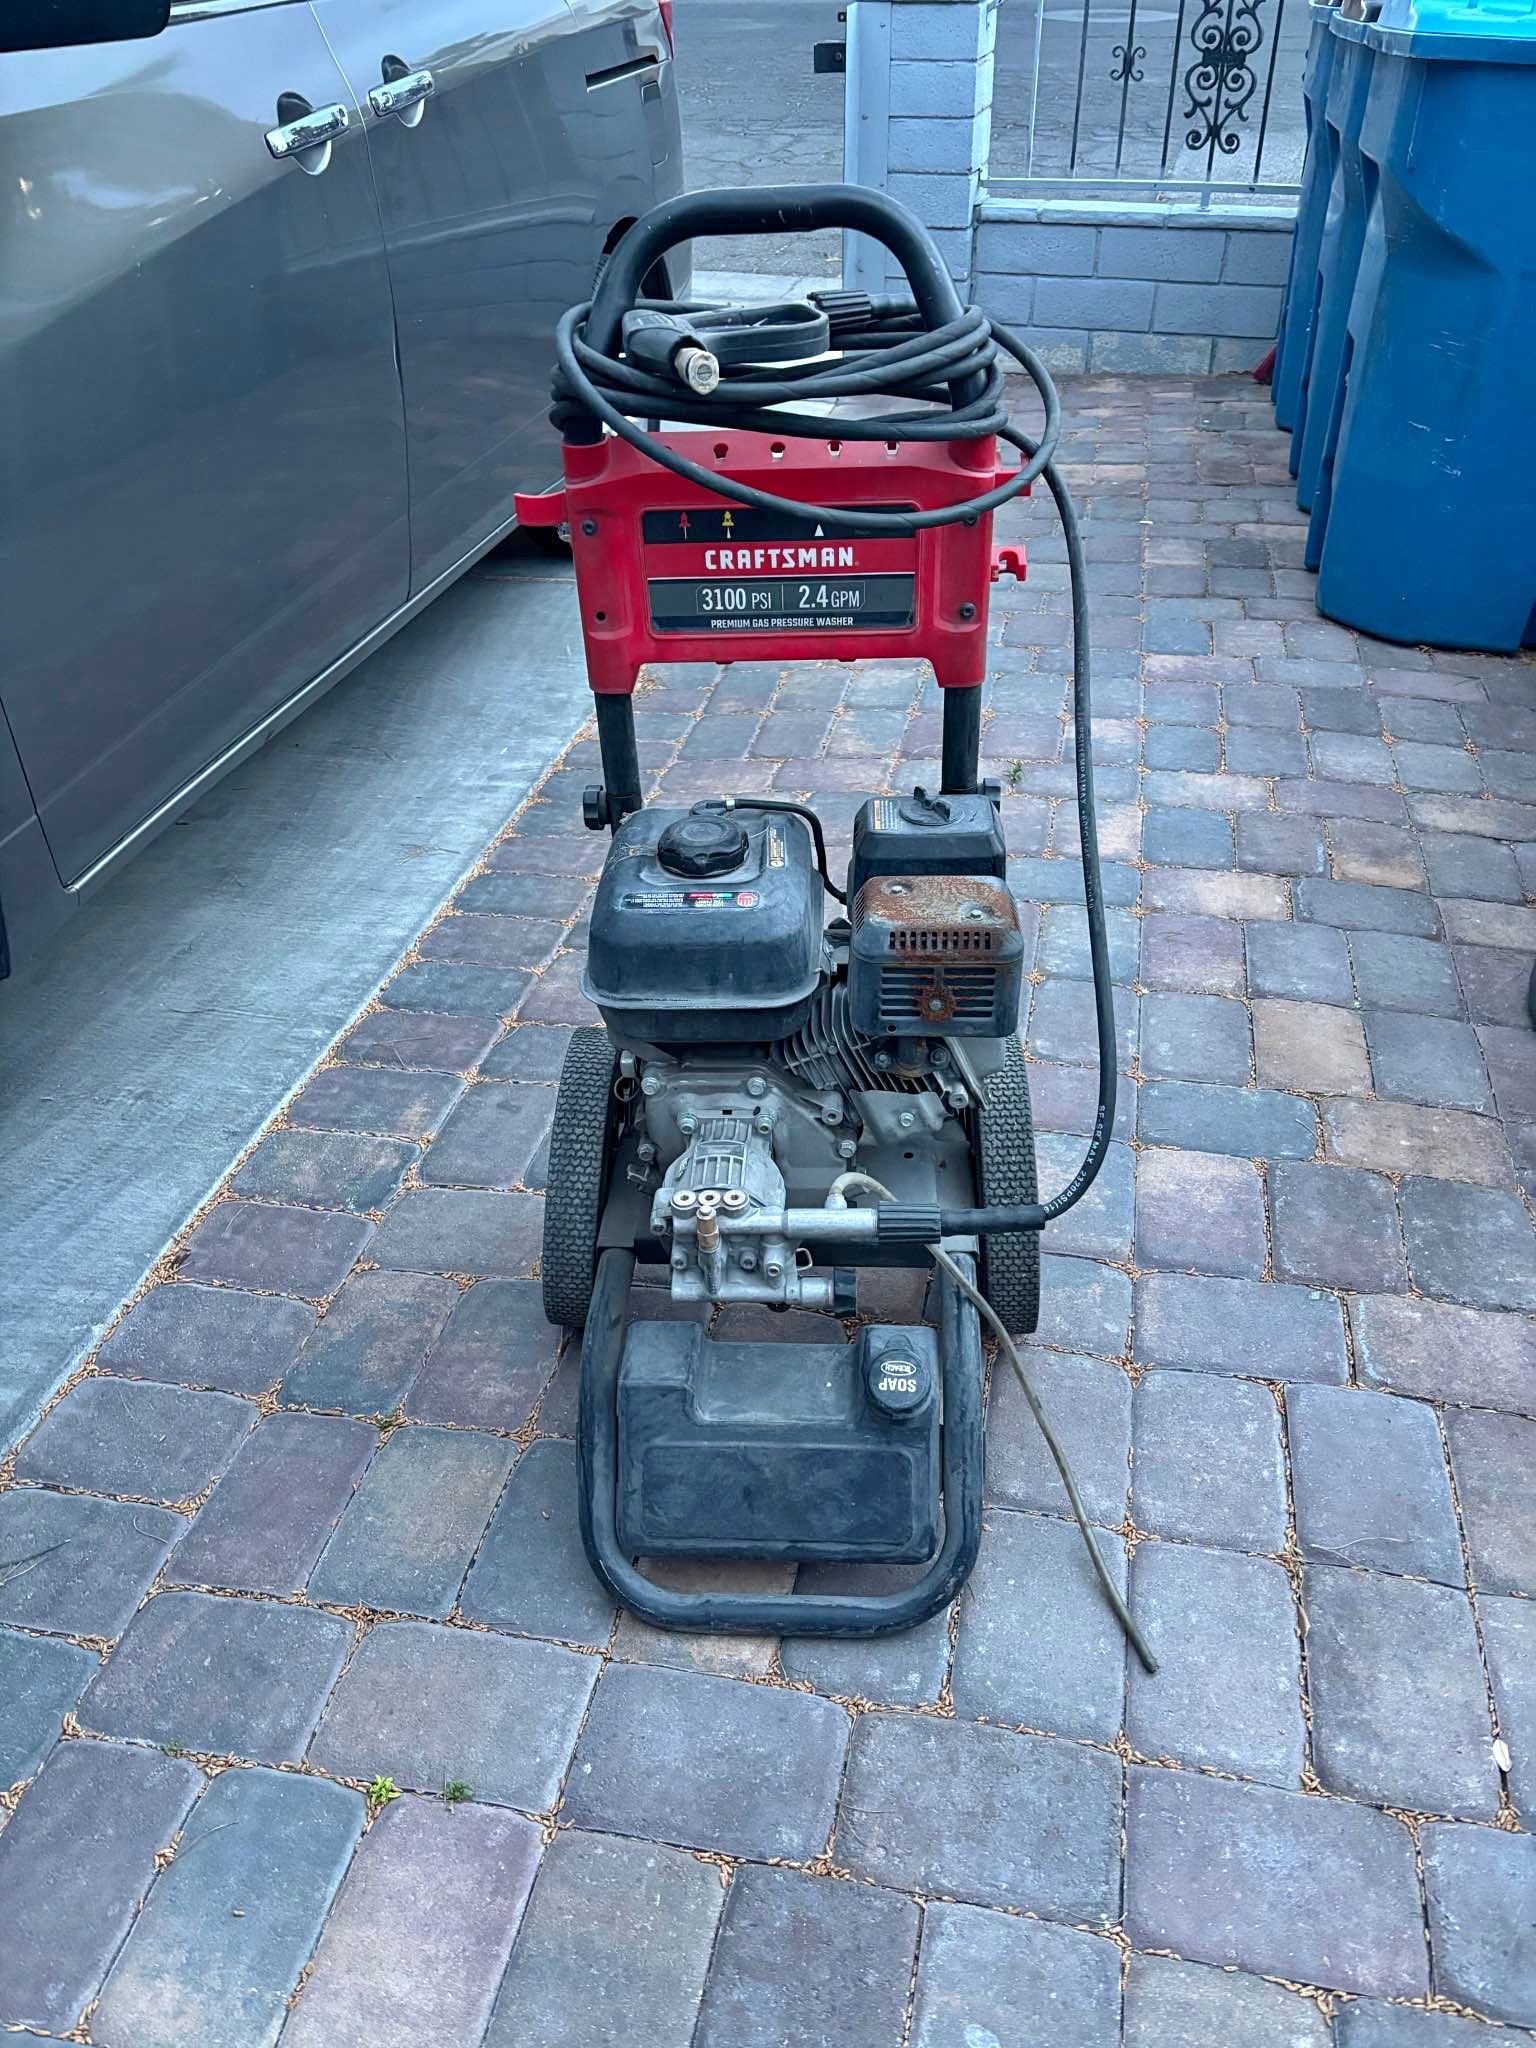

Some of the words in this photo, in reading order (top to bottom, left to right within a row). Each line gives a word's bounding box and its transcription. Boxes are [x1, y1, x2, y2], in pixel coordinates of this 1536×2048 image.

[704, 546, 854, 570] CRAFTSMAN
[701, 587, 746, 611] 3100
[751, 592, 772, 609] PSI
[798, 584, 829, 609] 2.4
[830, 589, 860, 608] GPM
[711, 619, 750, 629] PREMIUM
[752, 619, 769, 628] GAS
[771, 618, 814, 628] PRESSURE
[816, 617, 853, 627] WASHER
[1086, 1141, 1101, 1165] MAX
[878, 1377, 917, 1392] SOAP
